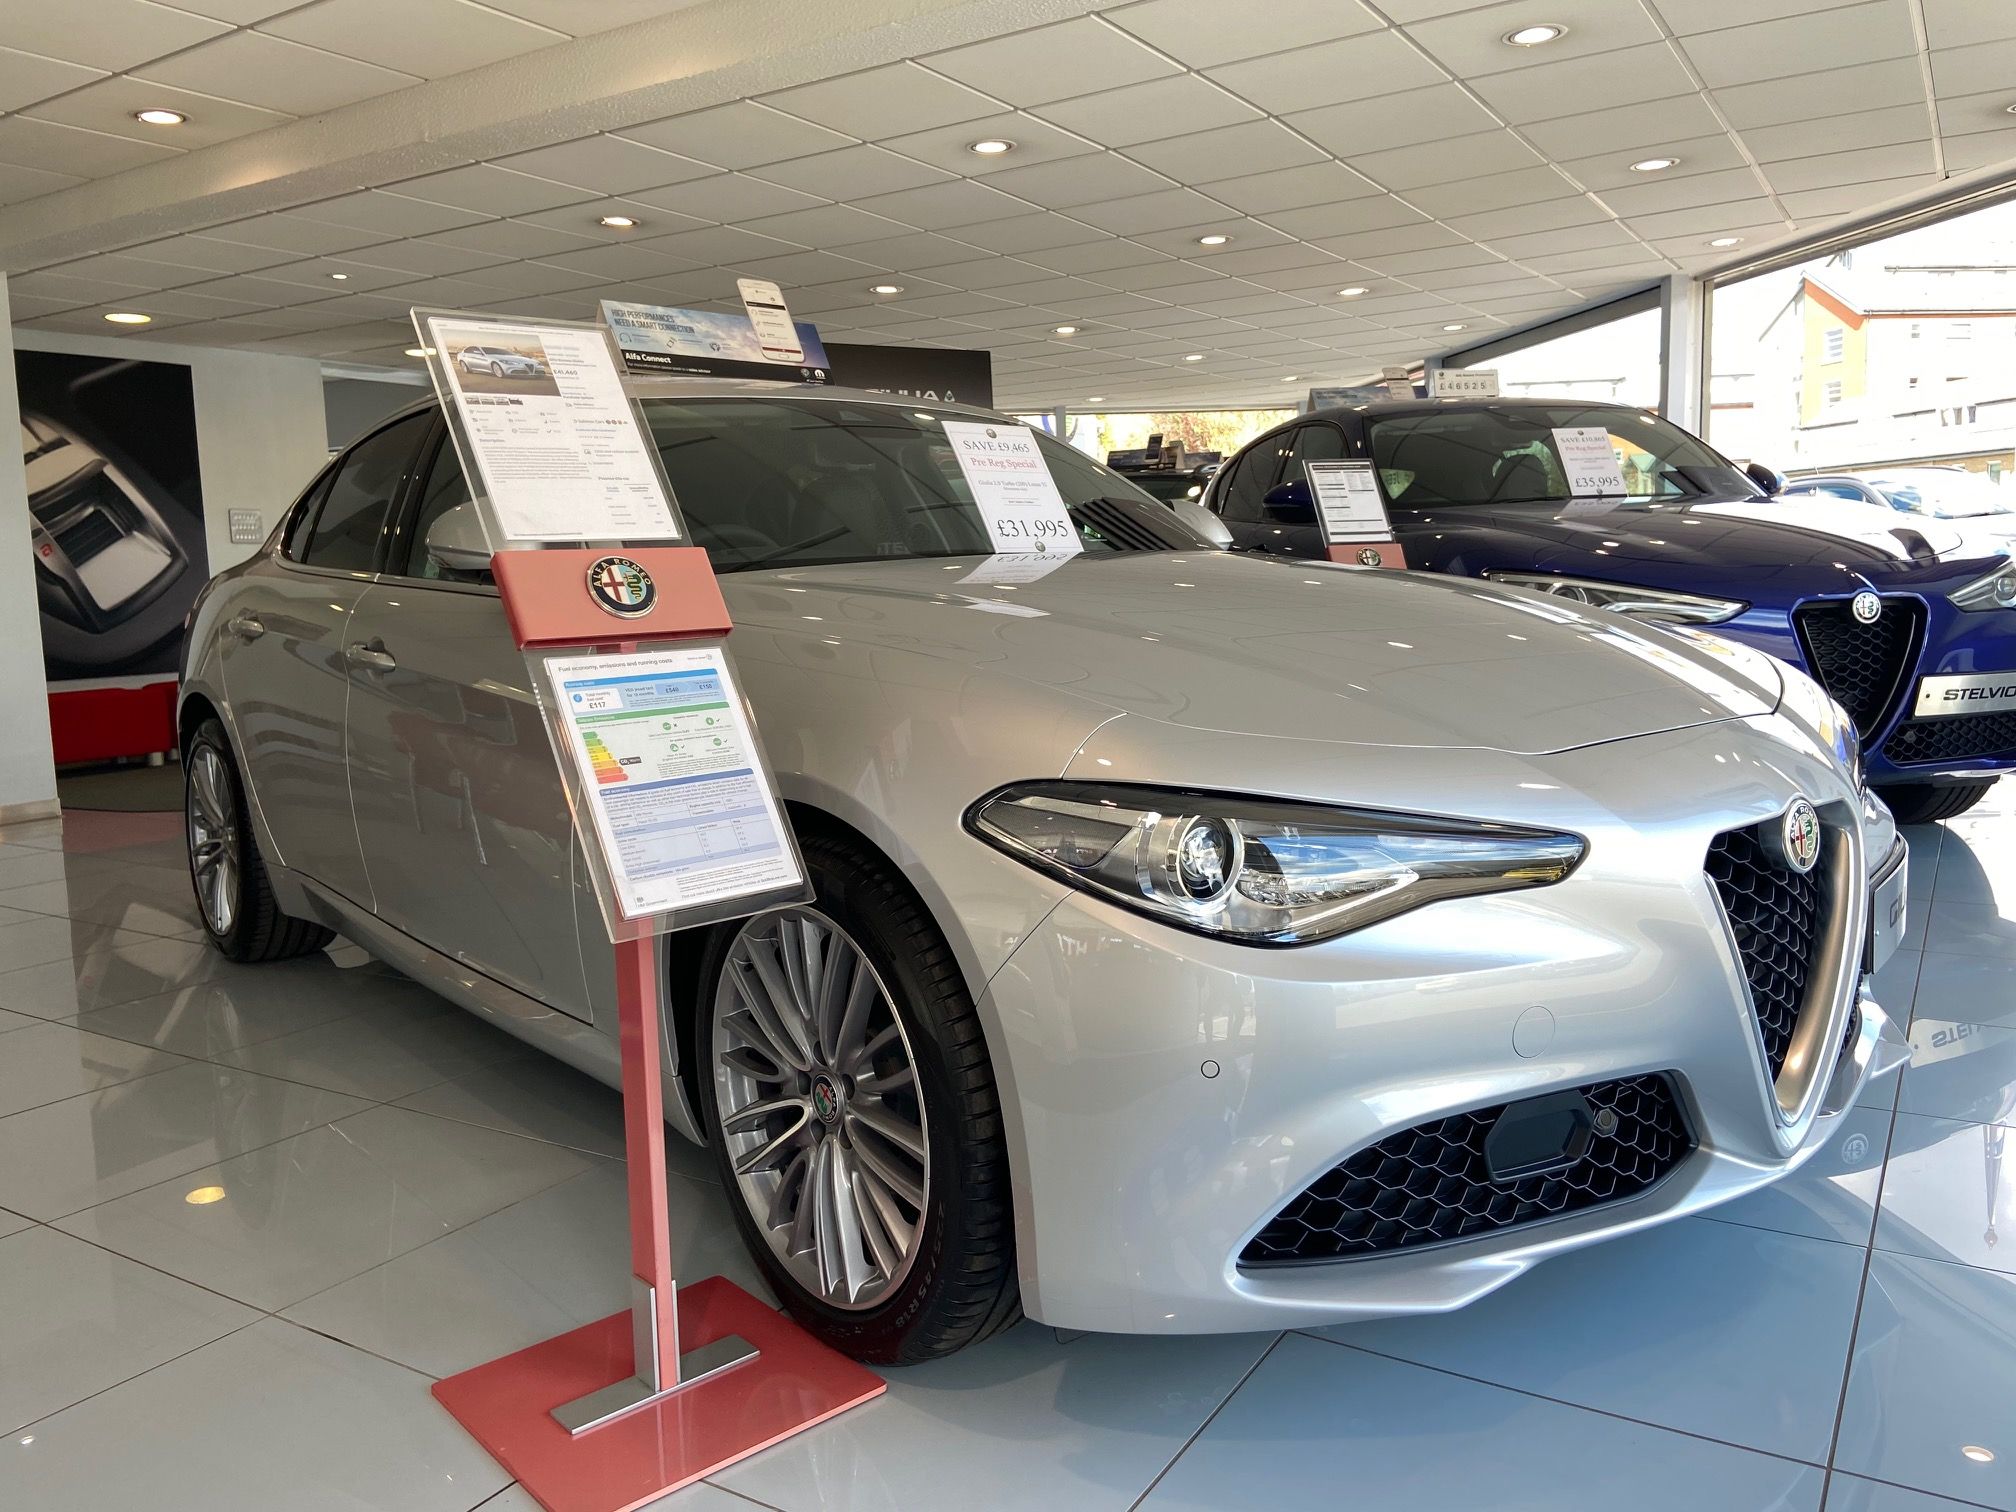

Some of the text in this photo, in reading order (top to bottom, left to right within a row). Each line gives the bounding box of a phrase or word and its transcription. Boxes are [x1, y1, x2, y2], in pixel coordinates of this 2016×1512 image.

[612, 309, 675, 323] HIGH PERFORMANCES
[614, 319, 631, 327] NEED
[636, 321, 658, 330] SMART
[658, 323, 695, 334] CONNECTION
[625, 352, 672, 364] Alfa Connect
[963, 440, 1030, 453] SAVE £9,465
[970, 457, 1037, 469] Pre Reg Special
[1575, 476, 1620, 488] £35,995
[997, 519, 1069, 540] £31,995
[593, 558, 652, 587] ALFA ROMEO
[572, 665, 598, 673] economy,
[1943, 686, 2016, 701] STELVIO
